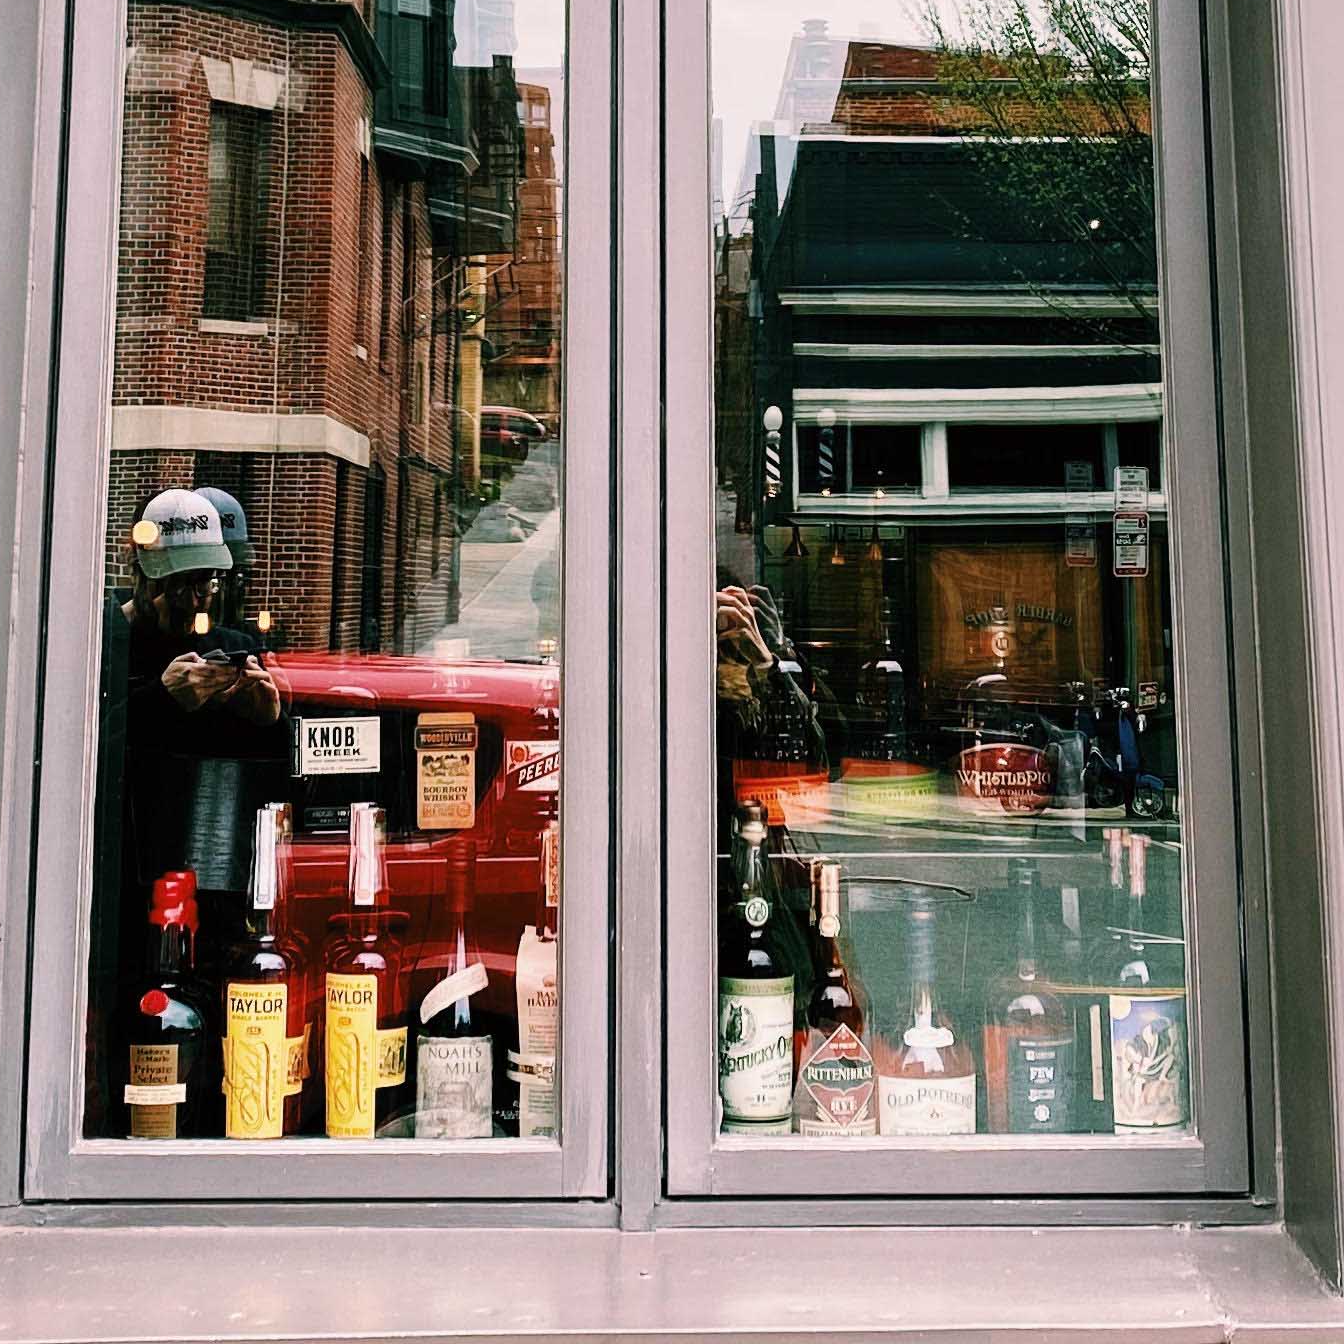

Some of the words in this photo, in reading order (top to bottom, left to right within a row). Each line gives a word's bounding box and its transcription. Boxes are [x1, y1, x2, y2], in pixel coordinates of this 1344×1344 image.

[308, 726, 355, 749] KNOB
[313, 748, 361, 757] CREEK
[422, 785, 469, 795] BOURBON
[422, 793, 468, 803] WHISKEY
[327, 987, 373, 1005] TAYLOR
[230, 997, 283, 1013] TAYLOR
[134, 1064, 173, 1074] Private
[446, 1061, 481, 1074] MILL
